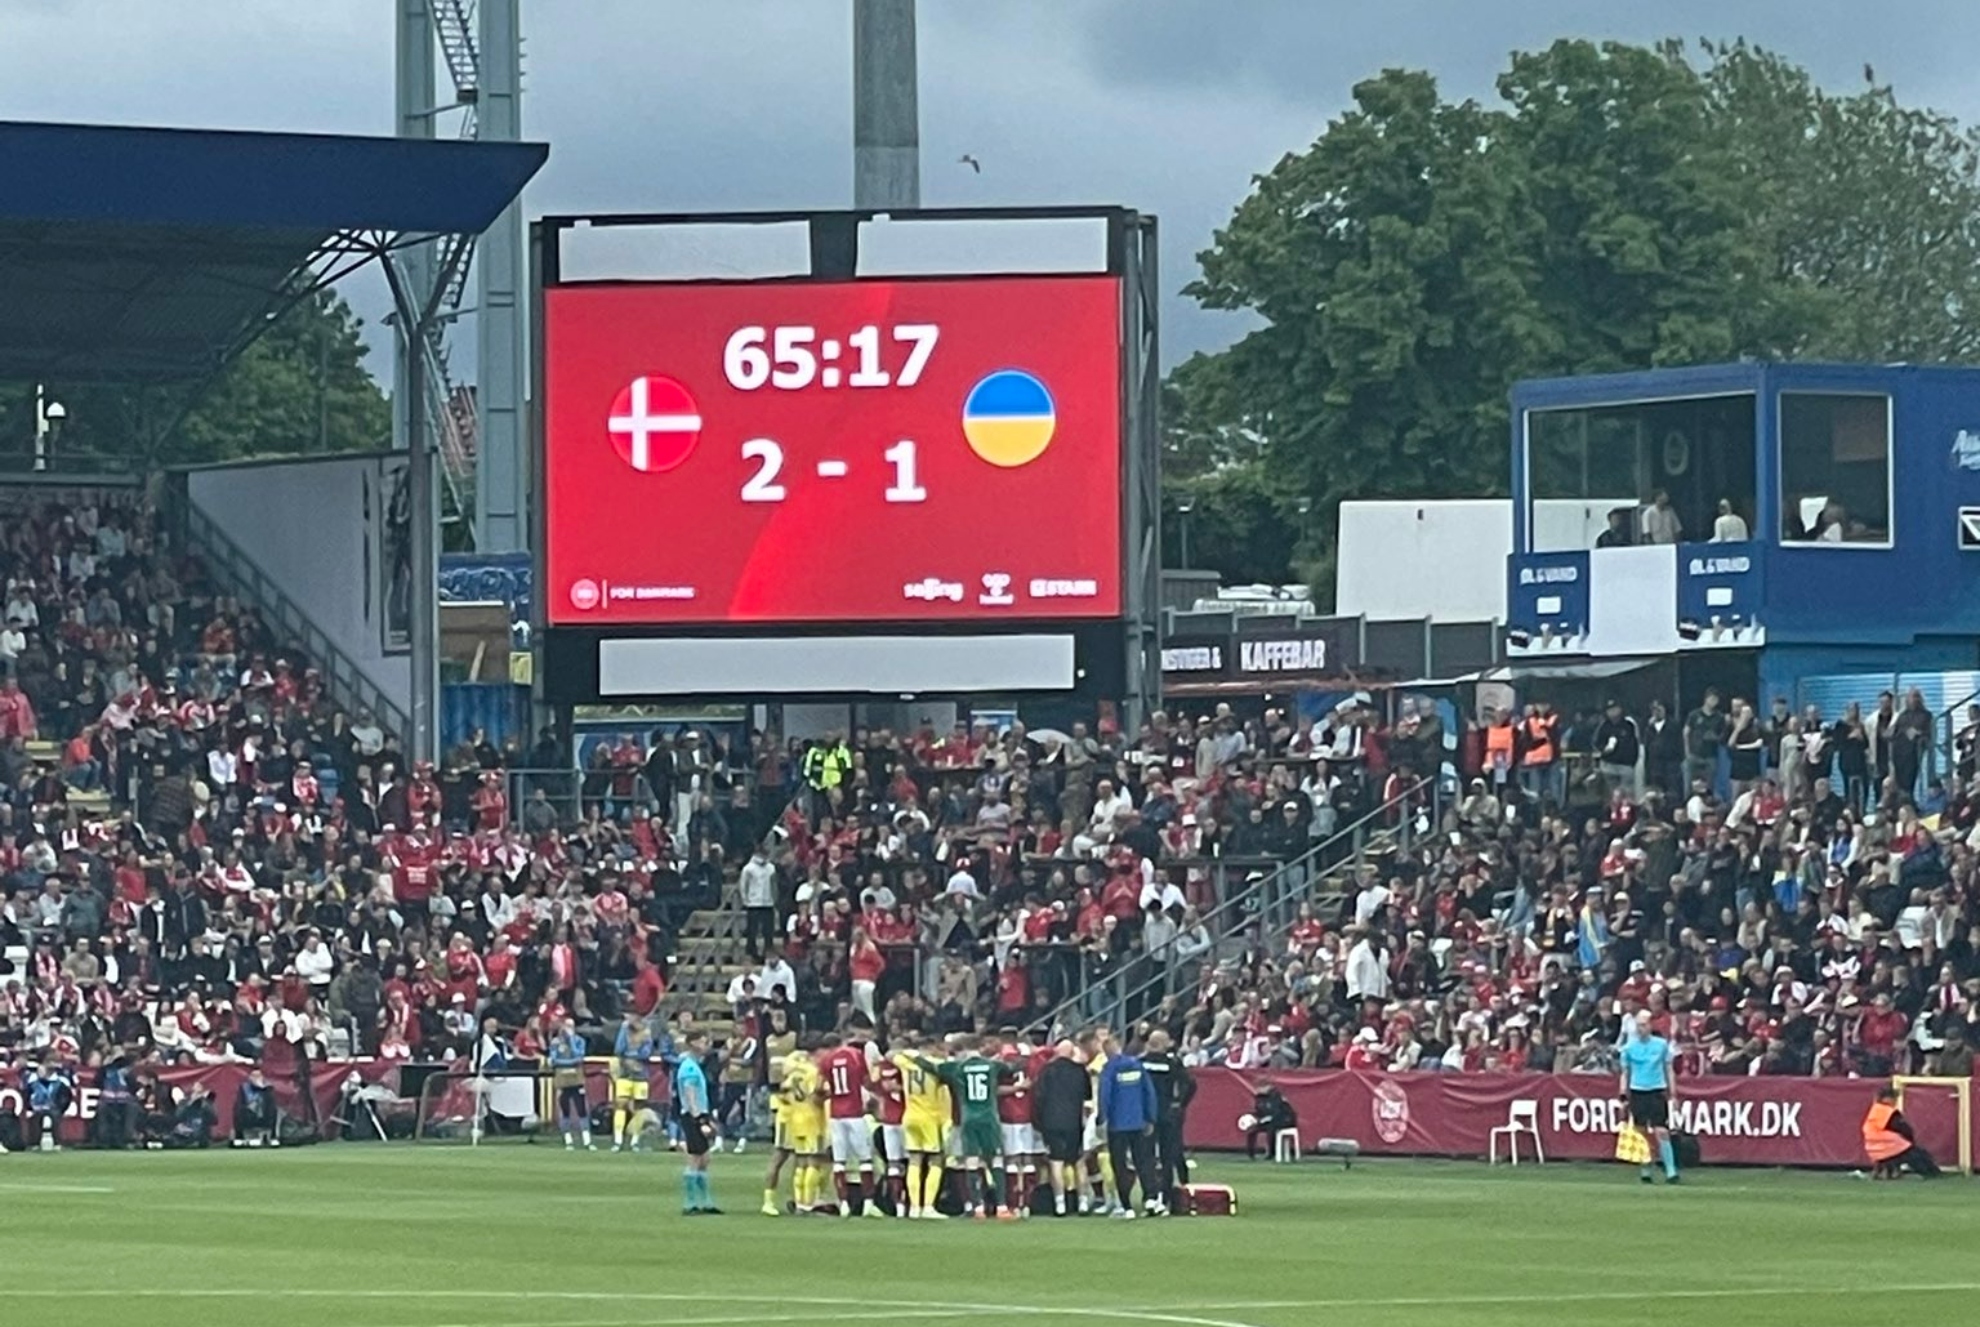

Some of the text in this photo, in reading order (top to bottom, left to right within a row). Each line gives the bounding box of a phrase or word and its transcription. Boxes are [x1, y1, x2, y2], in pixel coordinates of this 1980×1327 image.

[724, 323, 940, 390] 65:17
[741, 438, 786, 502] 2
[885, 440, 927, 502] 1
[1241, 640, 1325, 671] KAFFEBAR
[832, 1066, 850, 1096] 11
[966, 1072, 988, 1101] 16
[1553, 1098, 1801, 1137] FORDMARK.DK
